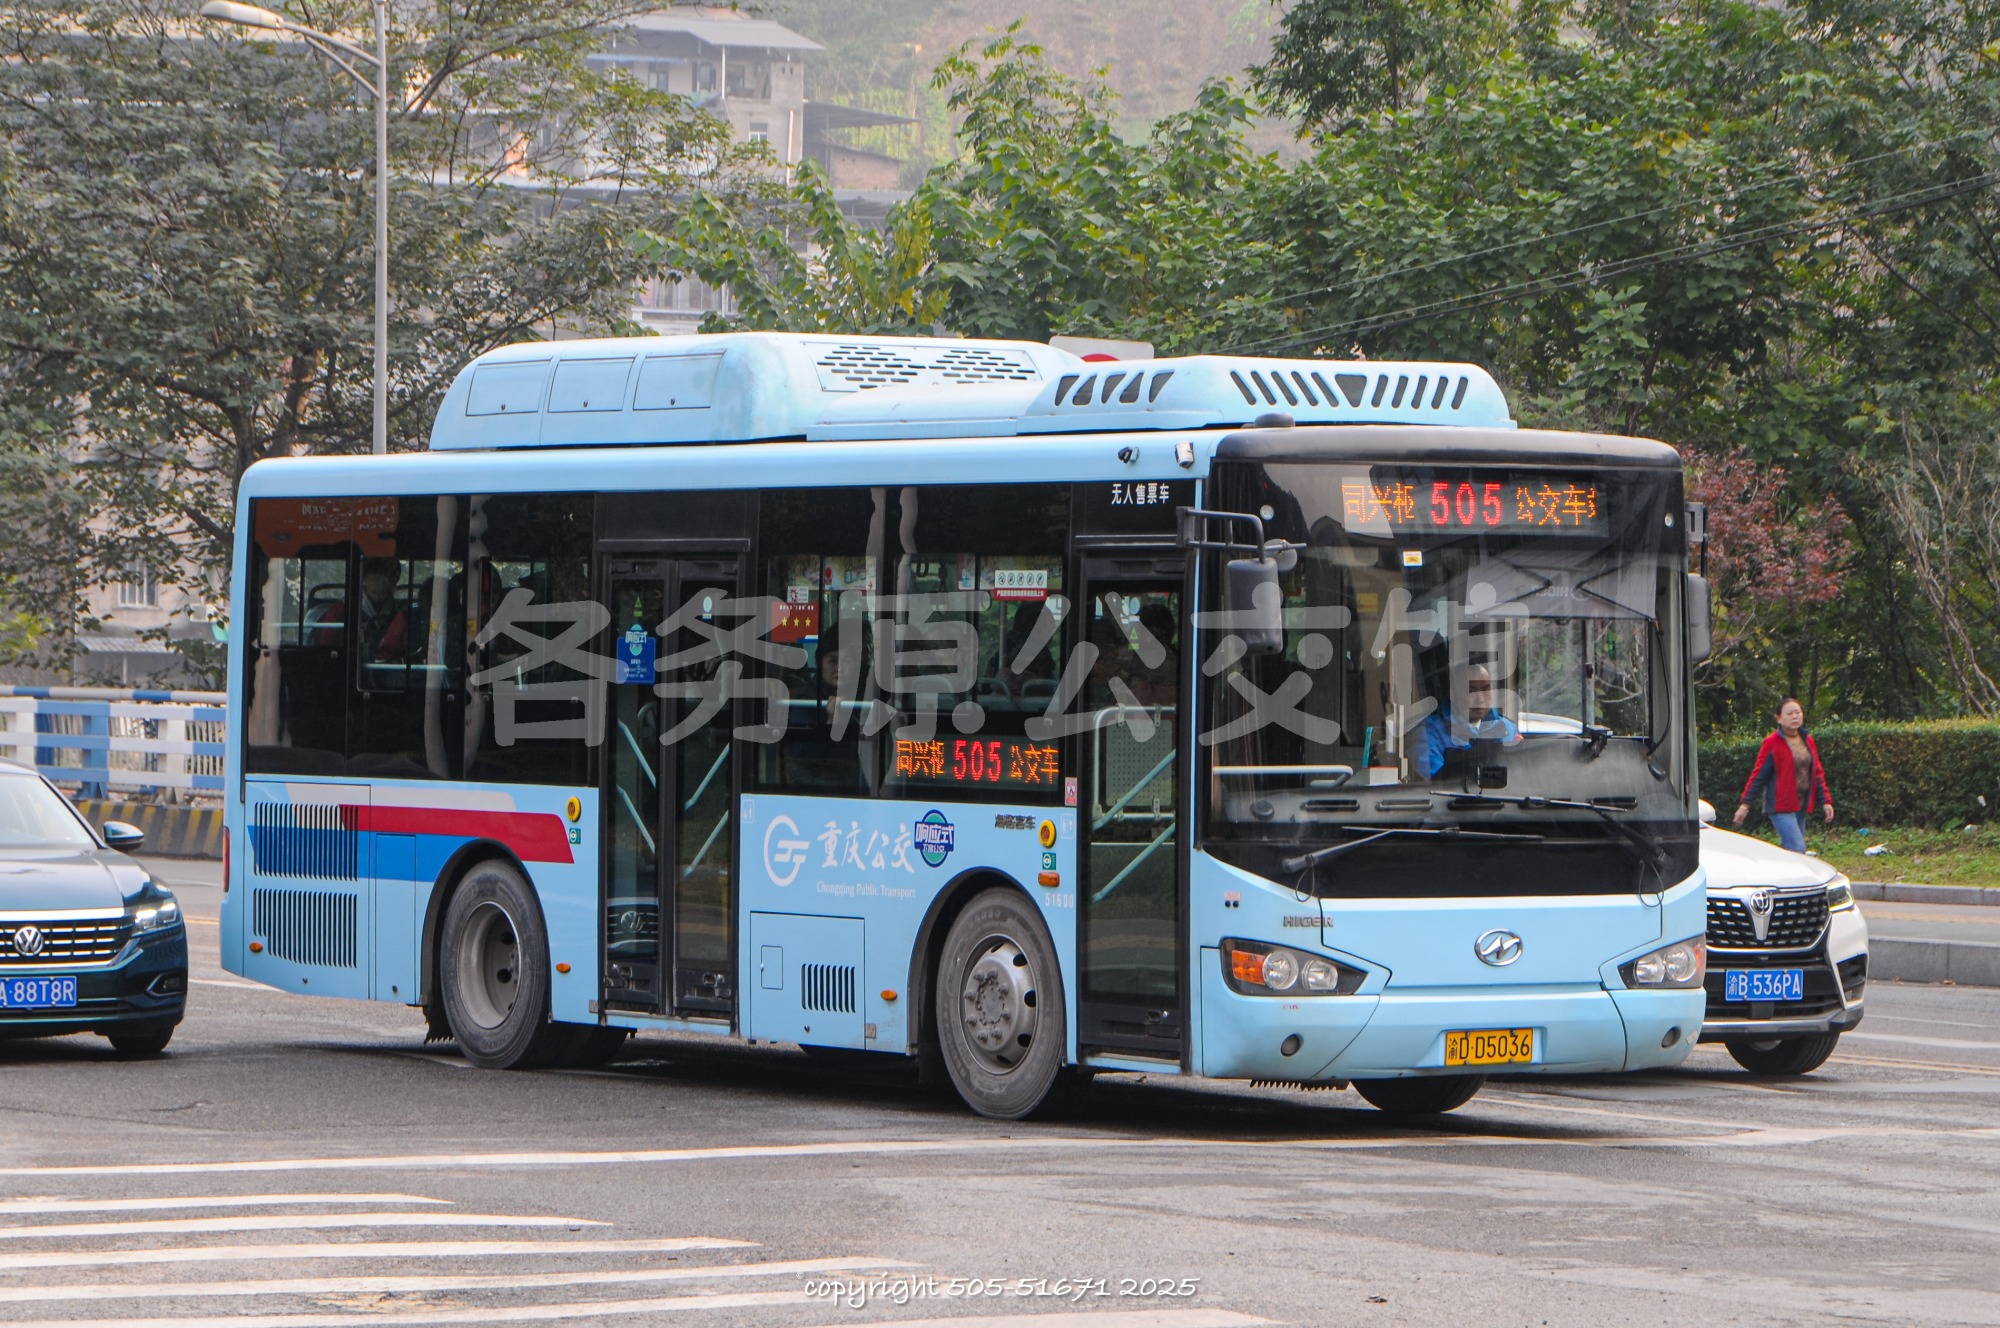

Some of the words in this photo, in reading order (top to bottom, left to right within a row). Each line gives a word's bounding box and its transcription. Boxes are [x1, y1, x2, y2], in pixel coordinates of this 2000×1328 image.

[1111, 482, 1170, 505] 无人售票车
[1431, 482, 1502, 525] 505
[953, 739, 1002, 782] 505
[1010, 743, 1060, 784] 公交车
[915, 823, 954, 845] 响应式
[817, 820, 915, 874] 重庆公交
[816, 880, 855, 897] Chongqing
[856, 882, 879, 896] Public
[881, 884, 916, 900] Transport
[1283, 915, 1334, 928] HIGER
